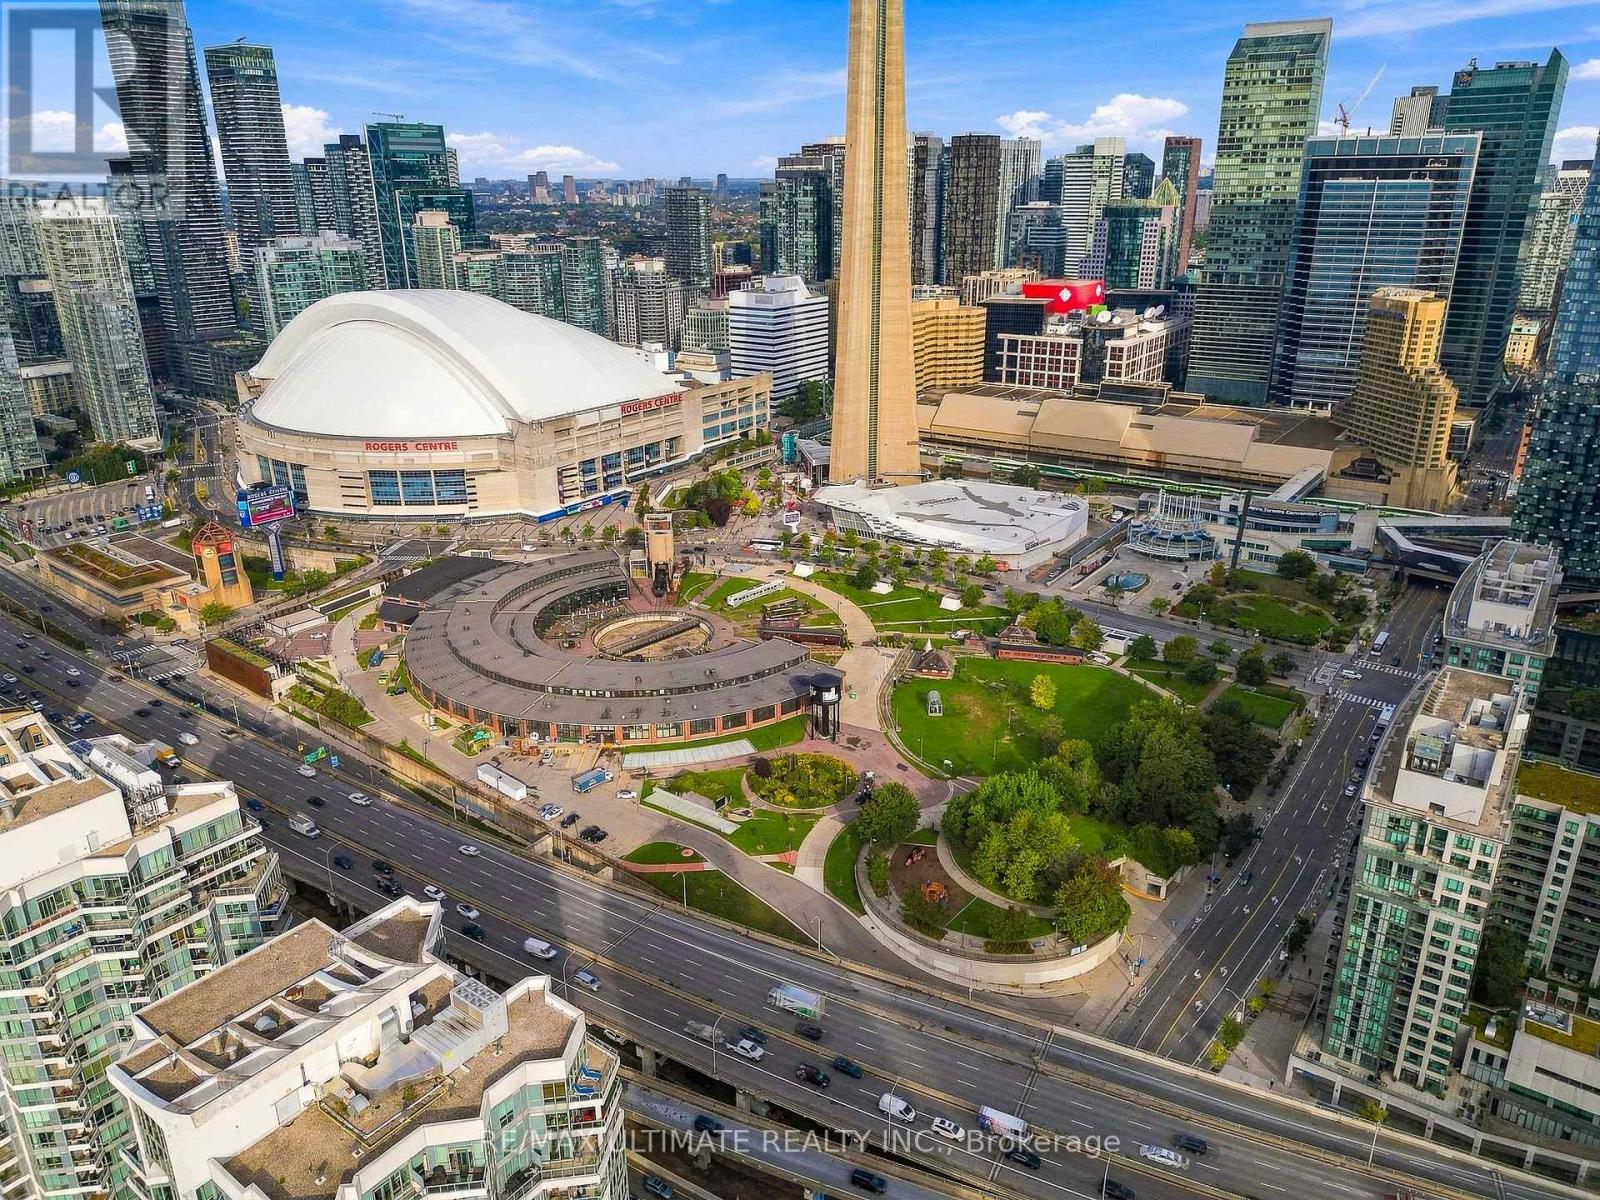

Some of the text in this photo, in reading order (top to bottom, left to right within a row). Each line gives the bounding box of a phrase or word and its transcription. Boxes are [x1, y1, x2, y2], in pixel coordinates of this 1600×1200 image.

[621, 394, 682, 414] ROGERS CENTRE
[365, 441, 458, 451] ROGERS CENTRE
